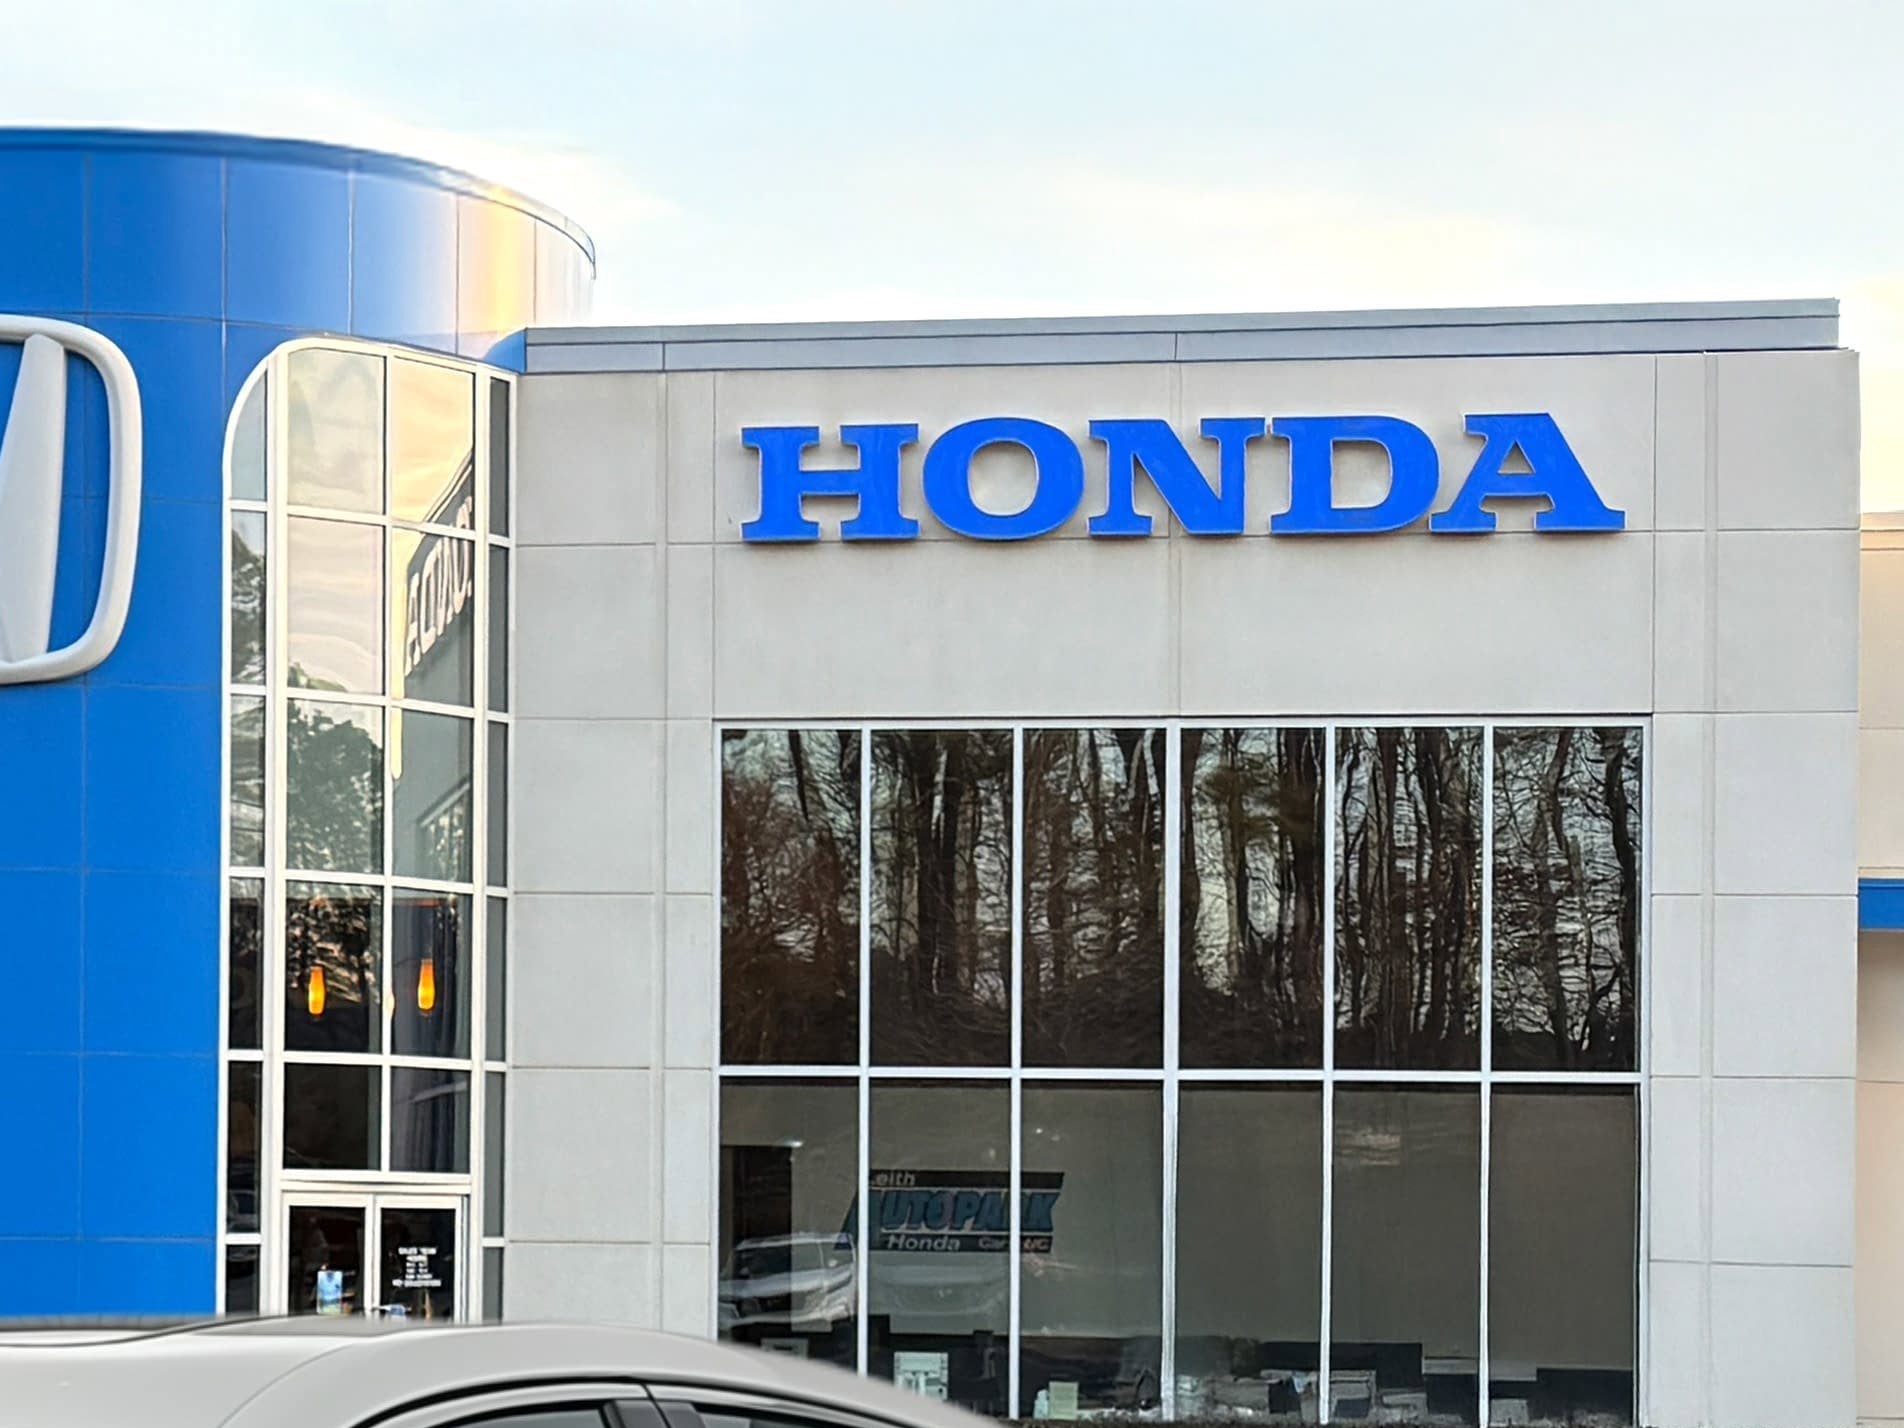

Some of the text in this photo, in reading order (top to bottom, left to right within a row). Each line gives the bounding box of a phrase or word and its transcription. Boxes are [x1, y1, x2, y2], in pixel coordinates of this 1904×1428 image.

[741, 411, 1626, 541] HONDA
[871, 1172, 916, 1187] eith
[888, 1233, 961, 1251] Honda
